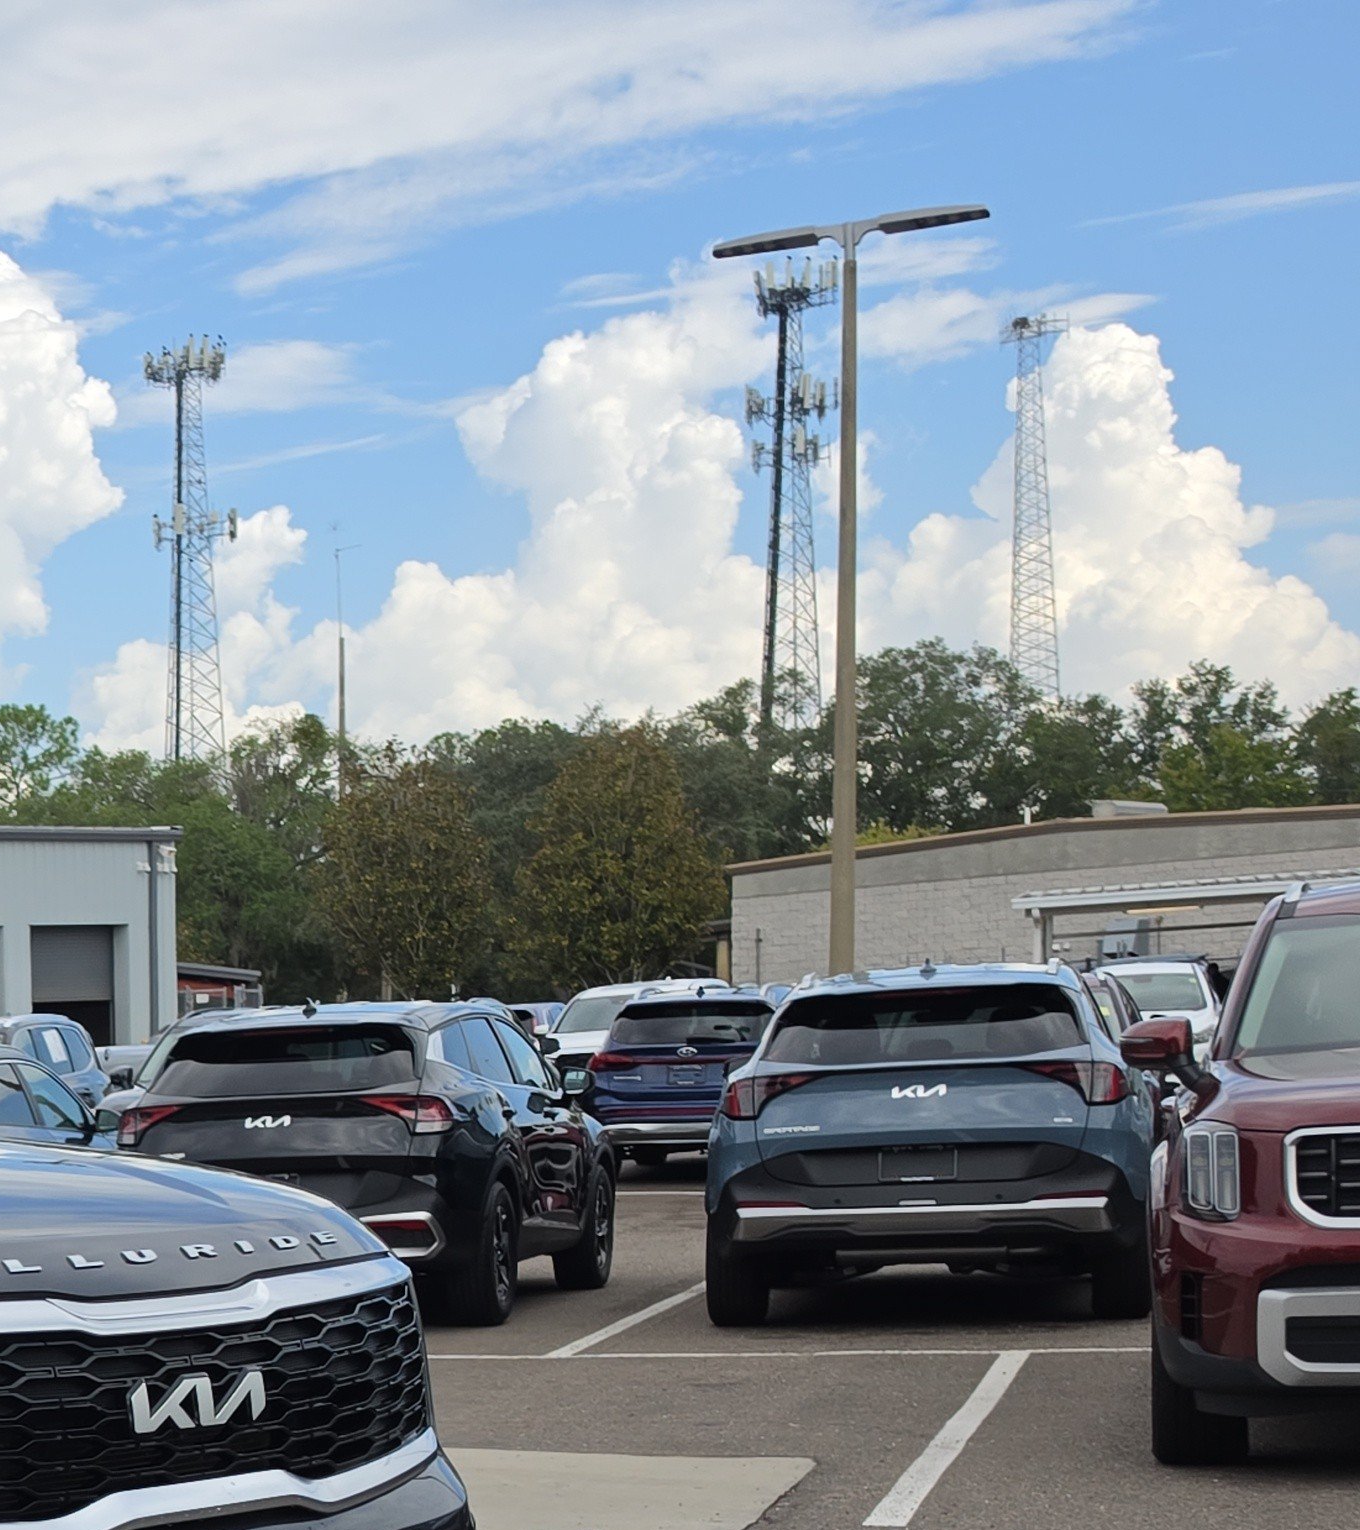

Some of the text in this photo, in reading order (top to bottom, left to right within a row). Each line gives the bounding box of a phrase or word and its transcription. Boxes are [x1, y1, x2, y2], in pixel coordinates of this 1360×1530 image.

[891, 1084, 947, 1099] KIA
[244, 1115, 291, 1129] KIA
[128, 1369, 266, 1434] KIA
